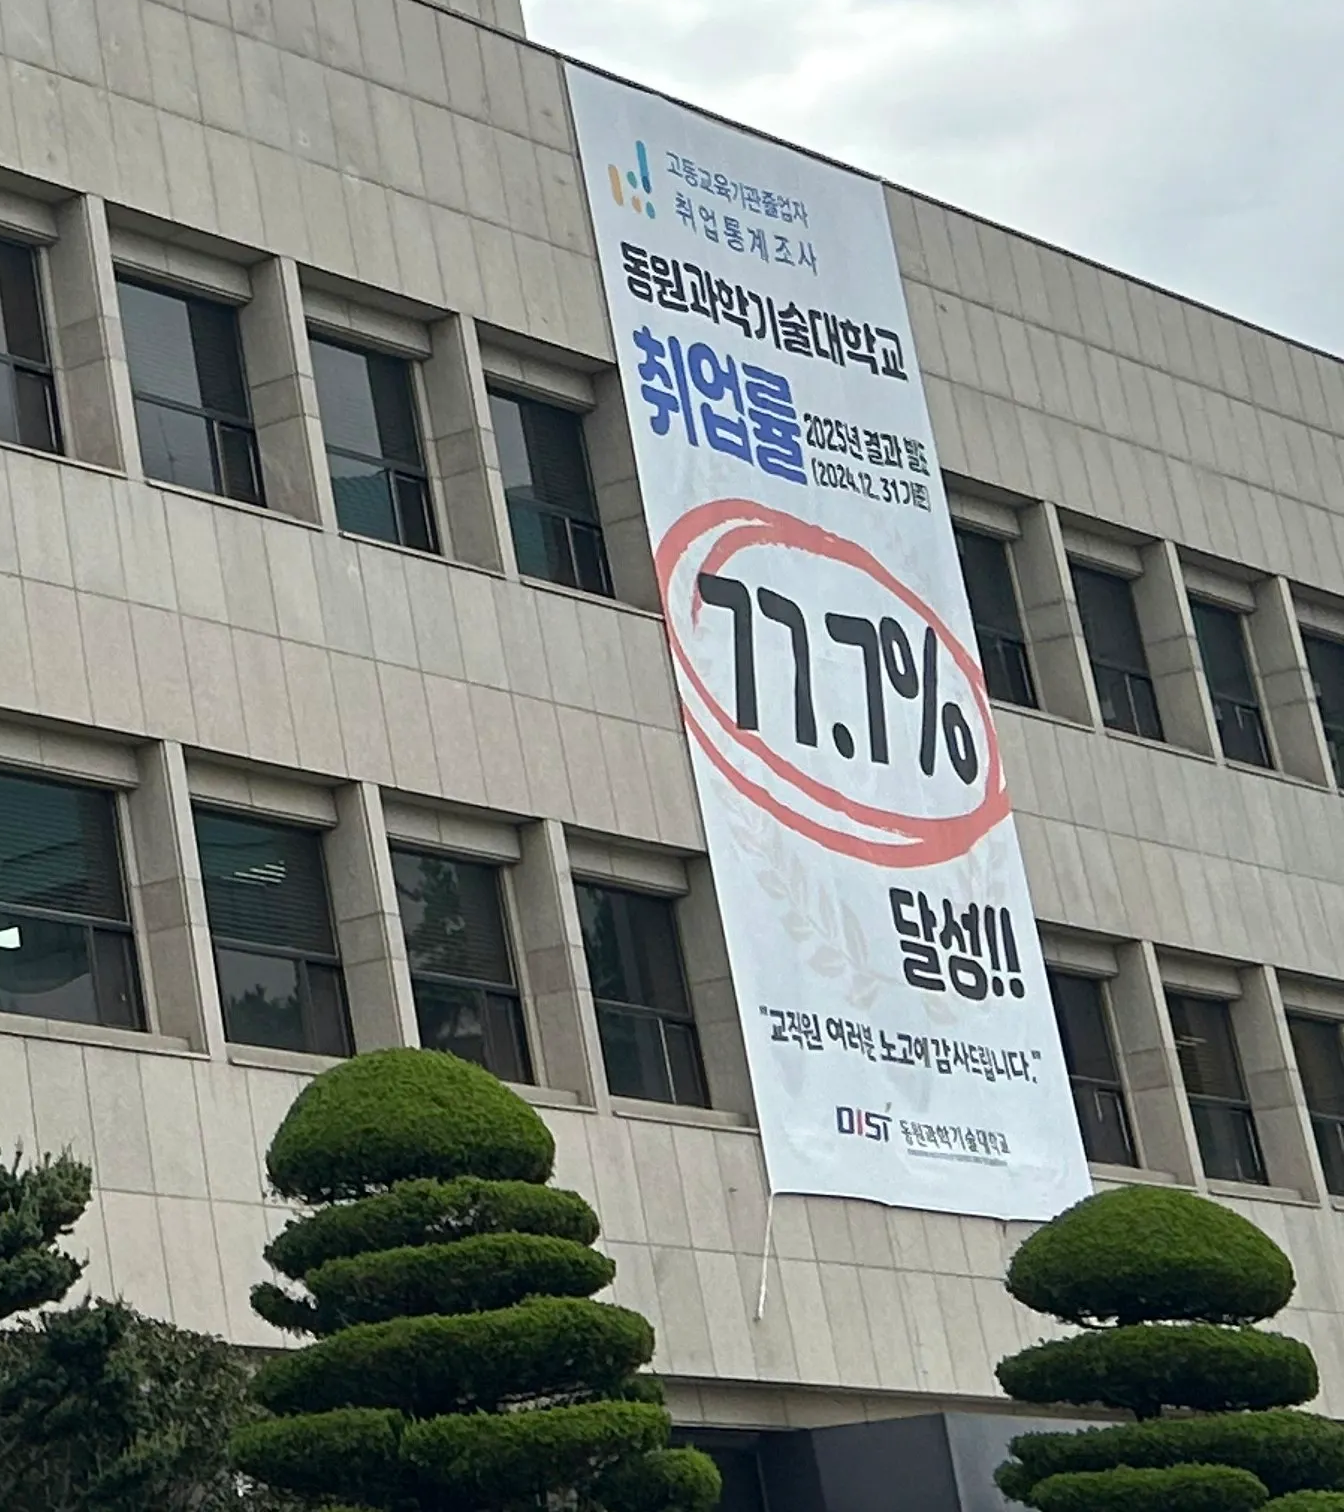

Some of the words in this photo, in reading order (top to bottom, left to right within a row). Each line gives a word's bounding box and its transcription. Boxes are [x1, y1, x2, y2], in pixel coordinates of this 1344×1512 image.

[666, 151, 808, 229] 고등교육기관졸업자
[620, 240, 909, 381] 동원과학기술대학교
[632, 325, 808, 486] 취업률
[803, 412, 864, 461] 2025년
[863, 428, 904, 469] 결과
[698, 571, 979, 786] 77.7%
[889, 887, 1026, 1001] 달성!!
[825, 1017, 877, 1062] 여러분
